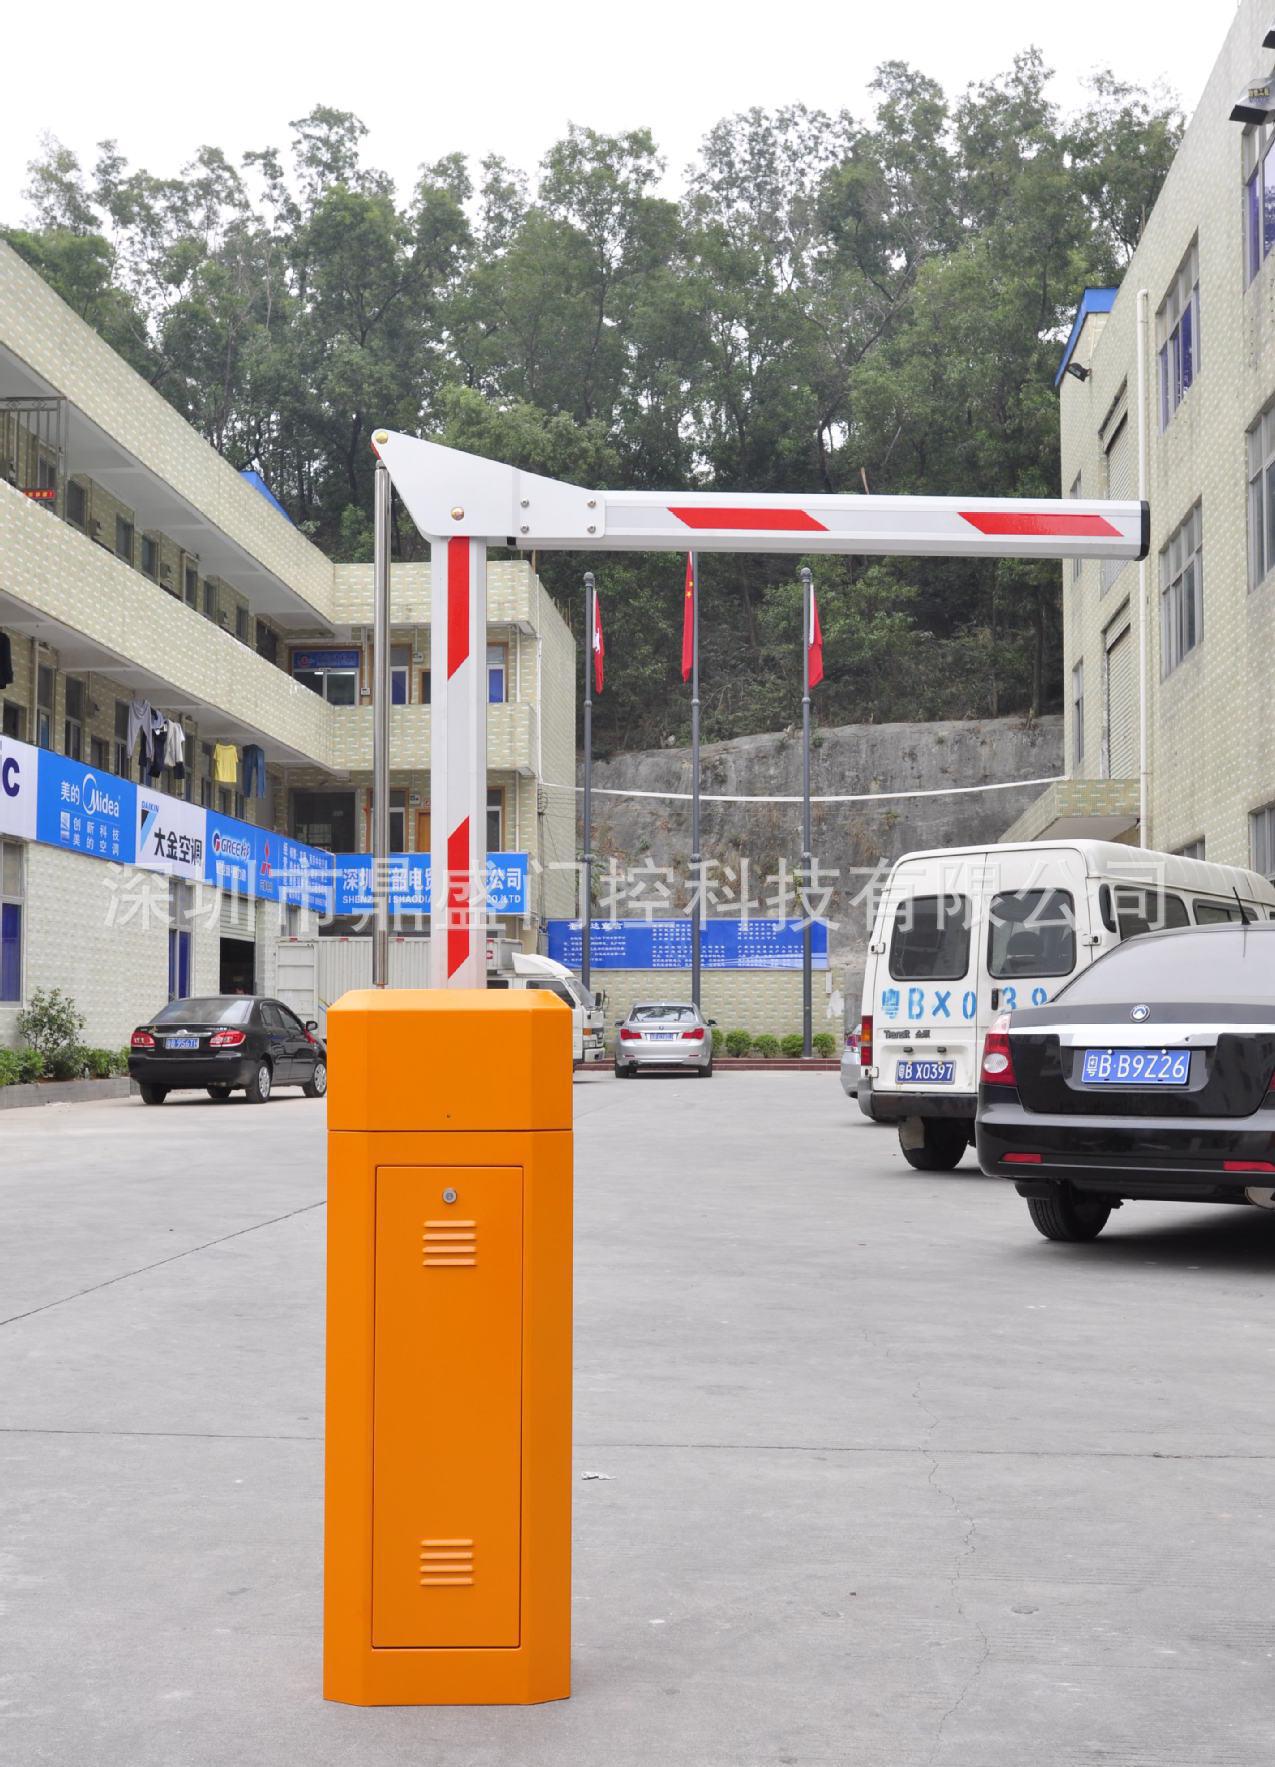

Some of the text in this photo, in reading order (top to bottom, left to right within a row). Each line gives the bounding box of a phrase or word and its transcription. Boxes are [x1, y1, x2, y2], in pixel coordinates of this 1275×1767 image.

[60, 773, 119, 817] 美的 Midea
[154, 826, 203, 866] 大金空调
